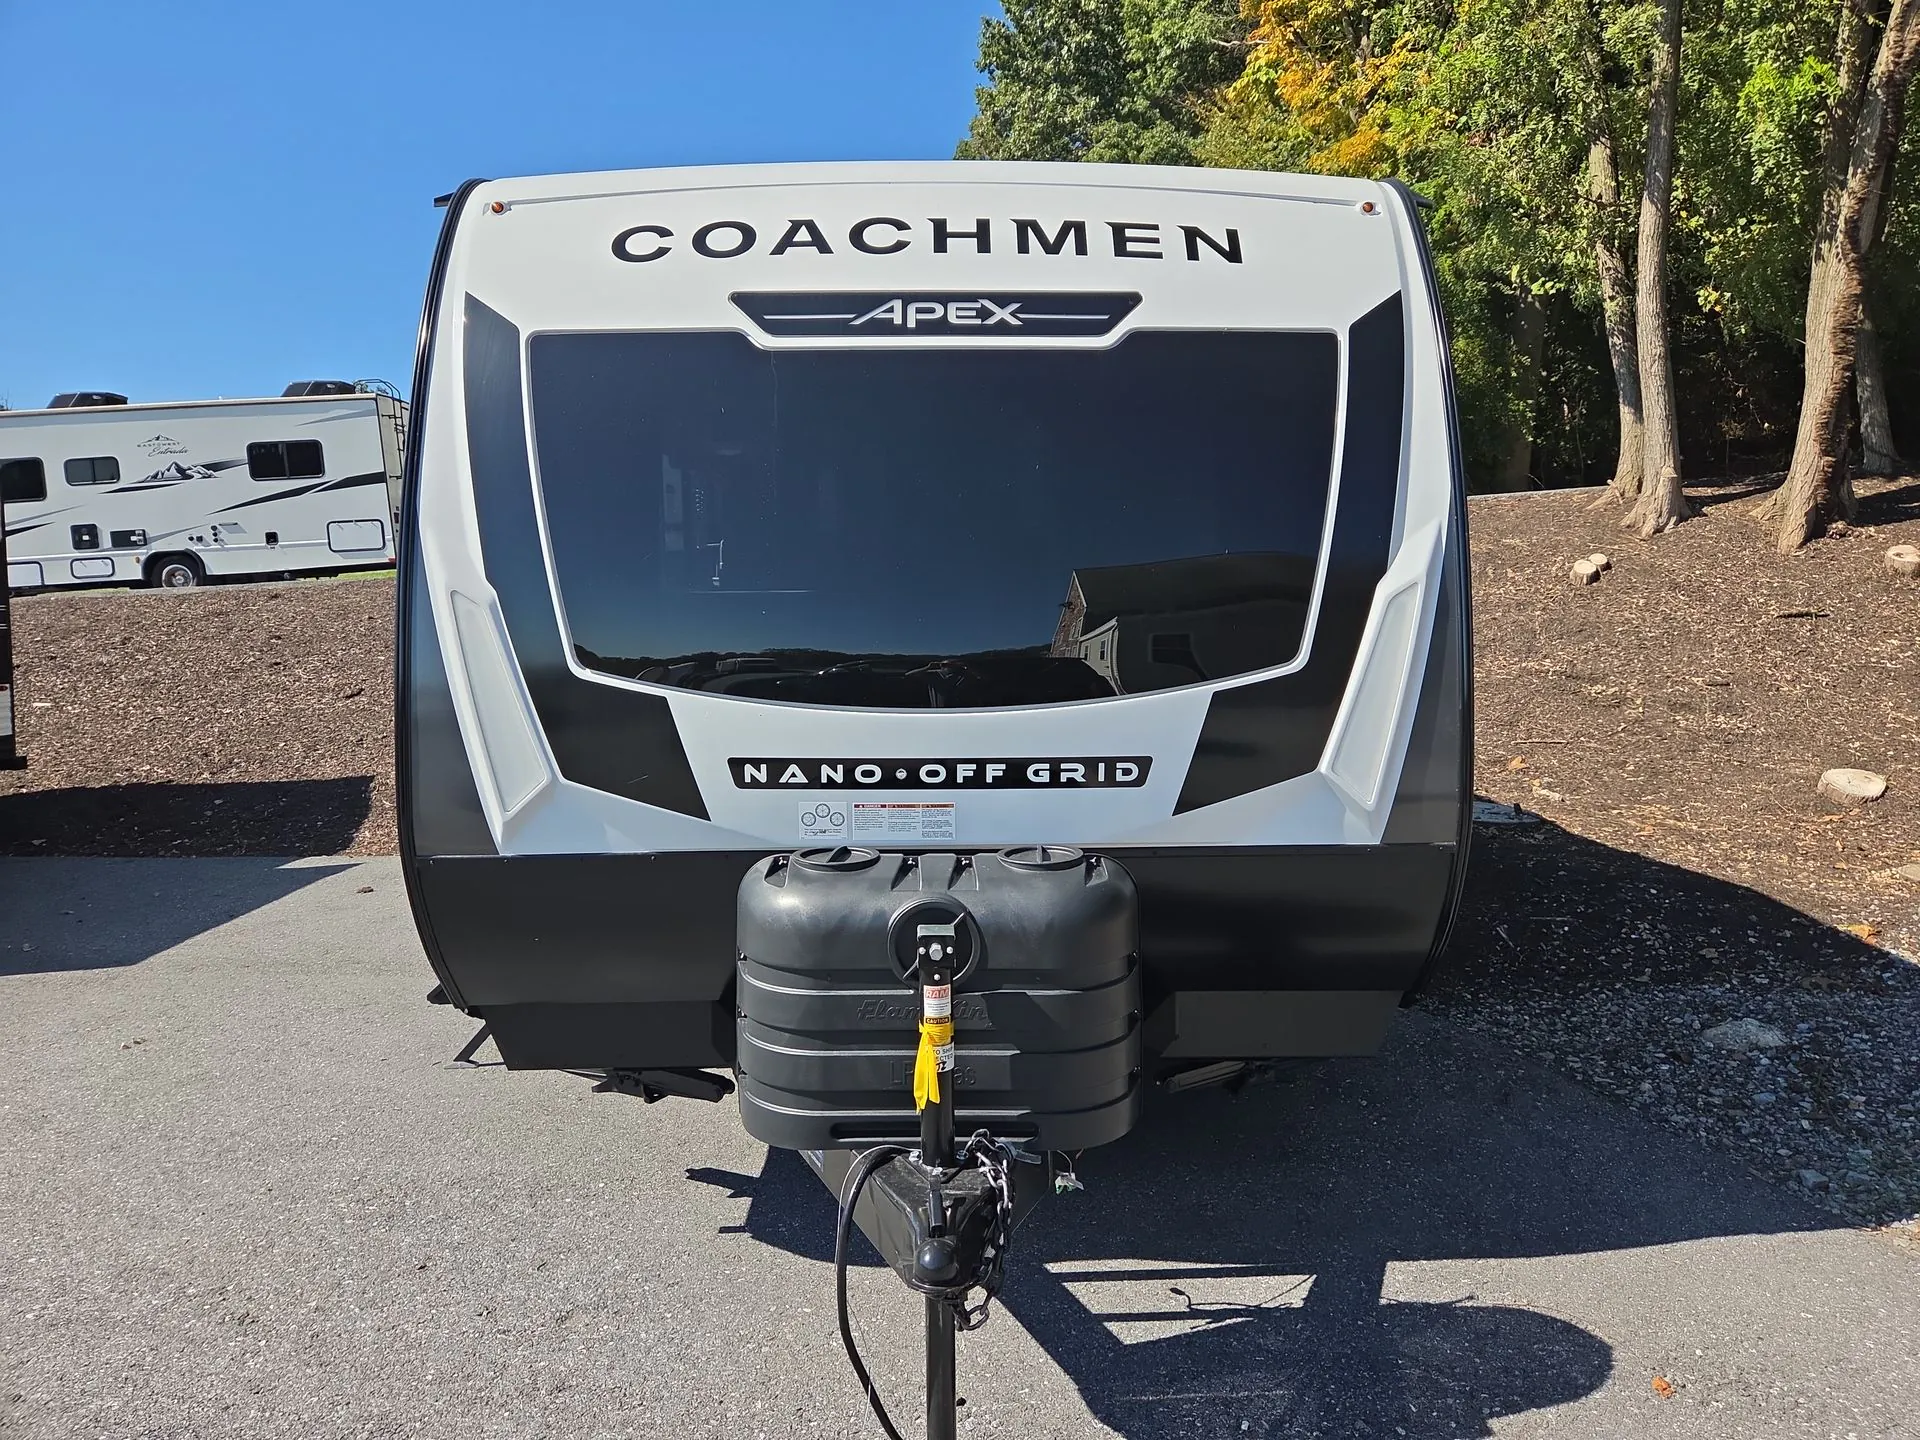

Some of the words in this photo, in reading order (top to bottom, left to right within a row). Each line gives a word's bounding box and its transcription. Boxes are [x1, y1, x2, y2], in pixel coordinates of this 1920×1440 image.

[611, 216, 1243, 264] COACHMEN
[848, 298, 1023, 328] APEX
[148, 446, 189, 457] Entrada
[744, 763, 882, 783] NANO
[919, 763, 1007, 783] OFF
[1027, 762, 1141, 783] GRID
[925, 988, 949, 999] RAM
[857, 999, 921, 1021] Flam
[935, 1053, 953, 1062] ECTED
